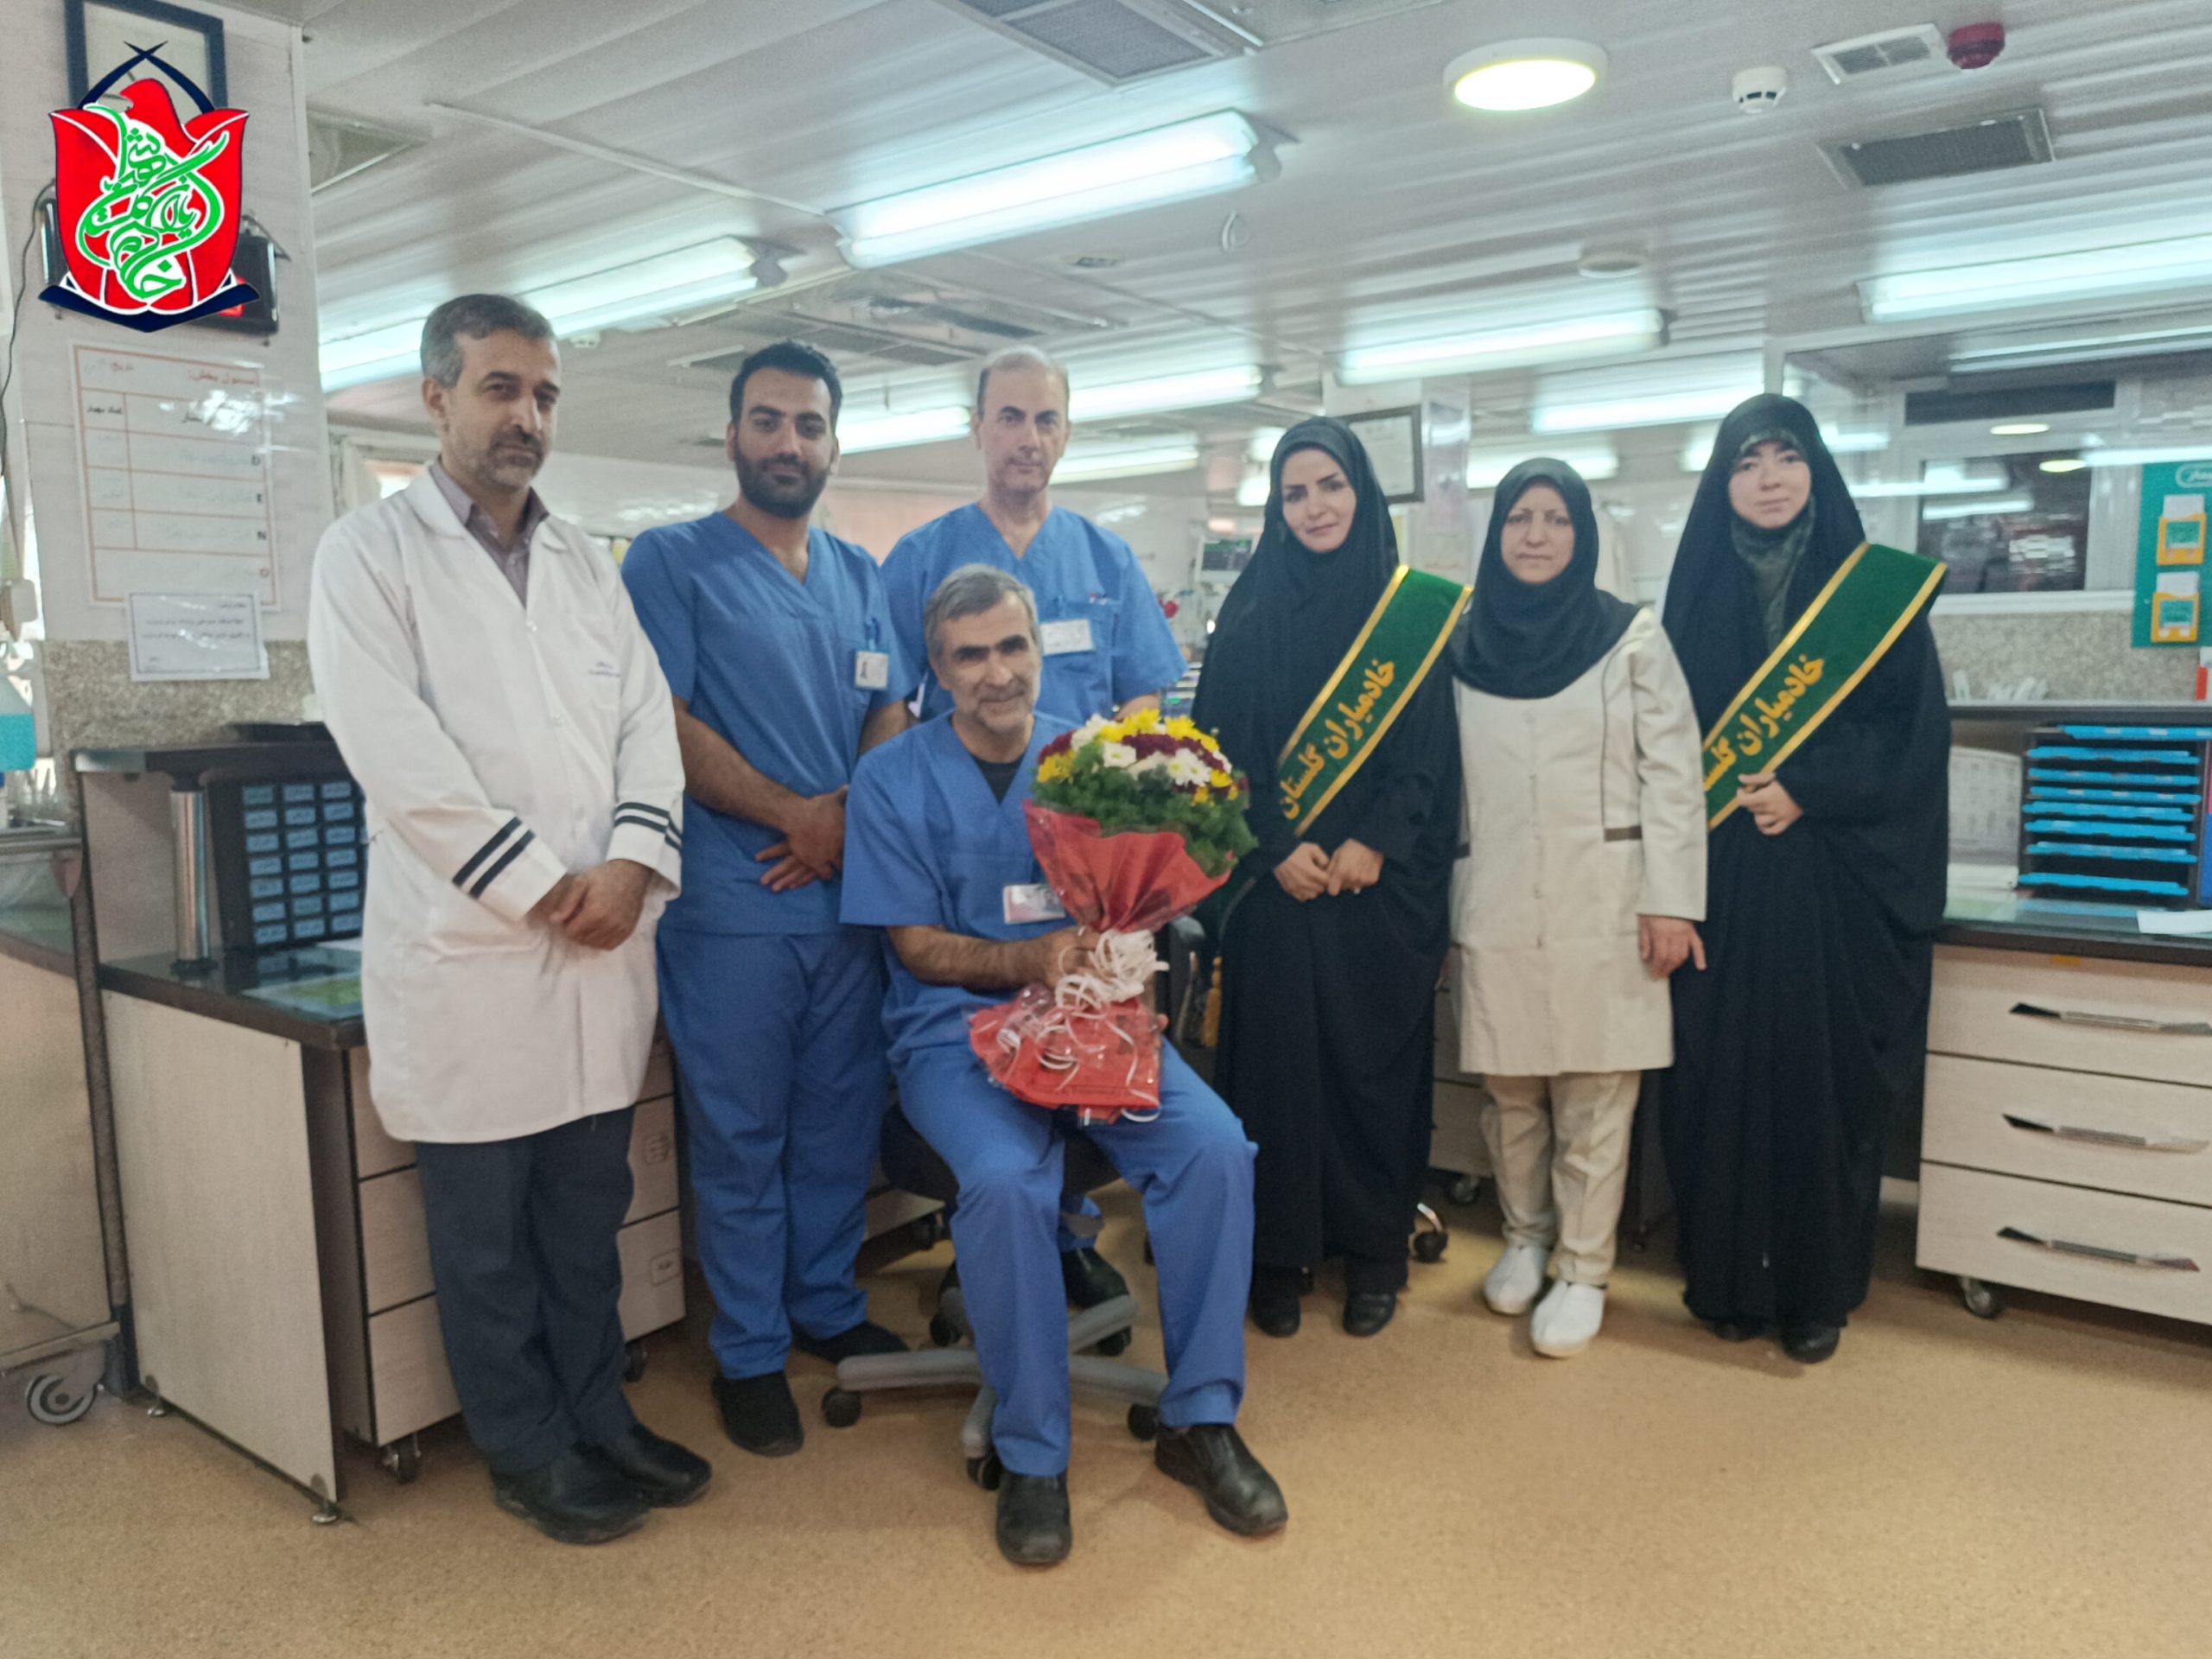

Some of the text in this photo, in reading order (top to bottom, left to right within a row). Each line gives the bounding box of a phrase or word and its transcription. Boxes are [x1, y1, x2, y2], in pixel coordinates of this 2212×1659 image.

[1279, 658, 1395, 820] خادمیاران گلستان
[1736, 653, 1825, 757] خادمیاران
